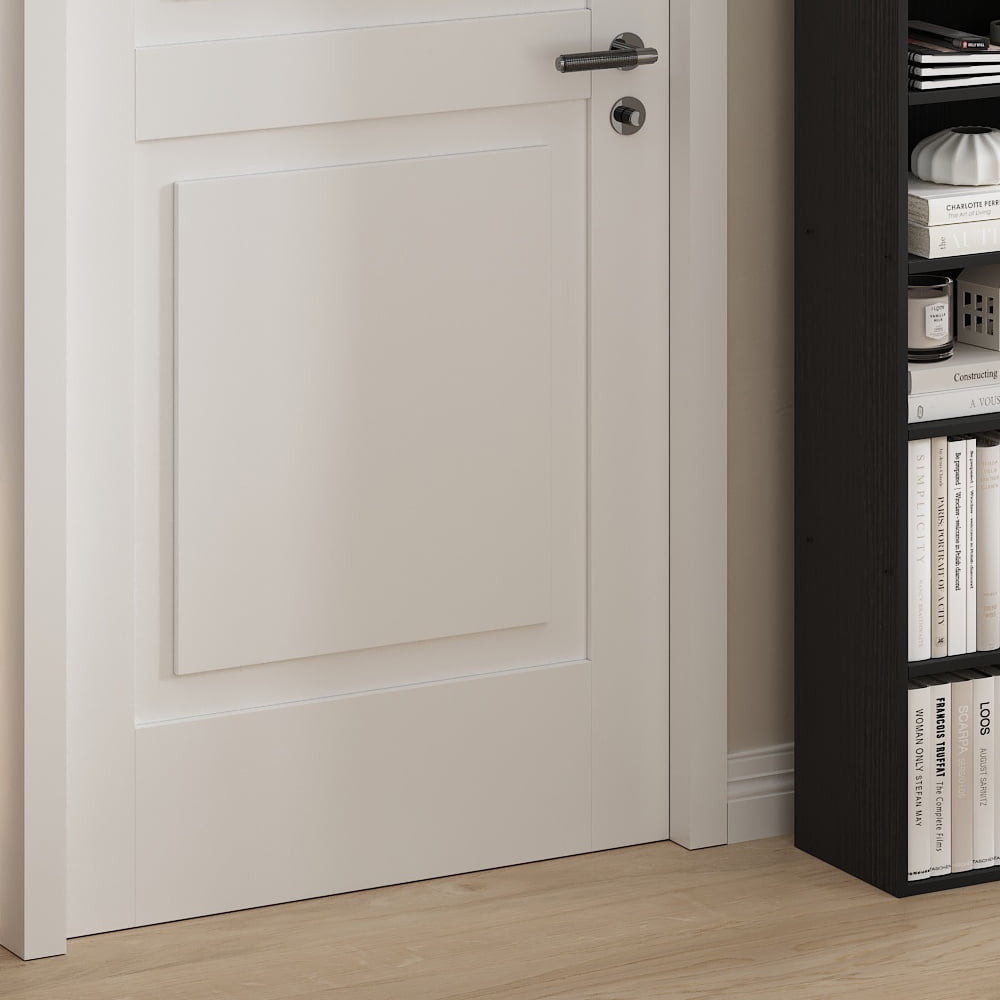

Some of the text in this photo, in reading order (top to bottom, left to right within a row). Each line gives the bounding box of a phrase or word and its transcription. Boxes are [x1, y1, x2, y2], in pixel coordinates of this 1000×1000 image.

[946, 201, 983, 211] CHARLOTTE
[975, 209, 992, 218] Living
[954, 370, 998, 383] Constructing
[970, 399, 976, 409] A
[979, 396, 1000, 407] VOUS
[916, 455, 925, 564] SIMPLICITY
[937, 497, 945, 626] PARIS: PORTRAIT OF A CITY
[958, 705, 969, 754] SCARPA
[980, 702, 991, 736] LOOS
[915, 708, 924, 827] WOMAN ONLY STEFAN MAY
[934, 697, 946, 852] FRANCOIS TRUFFAT The Complete Films
[979, 748, 987, 775] AUGUST
